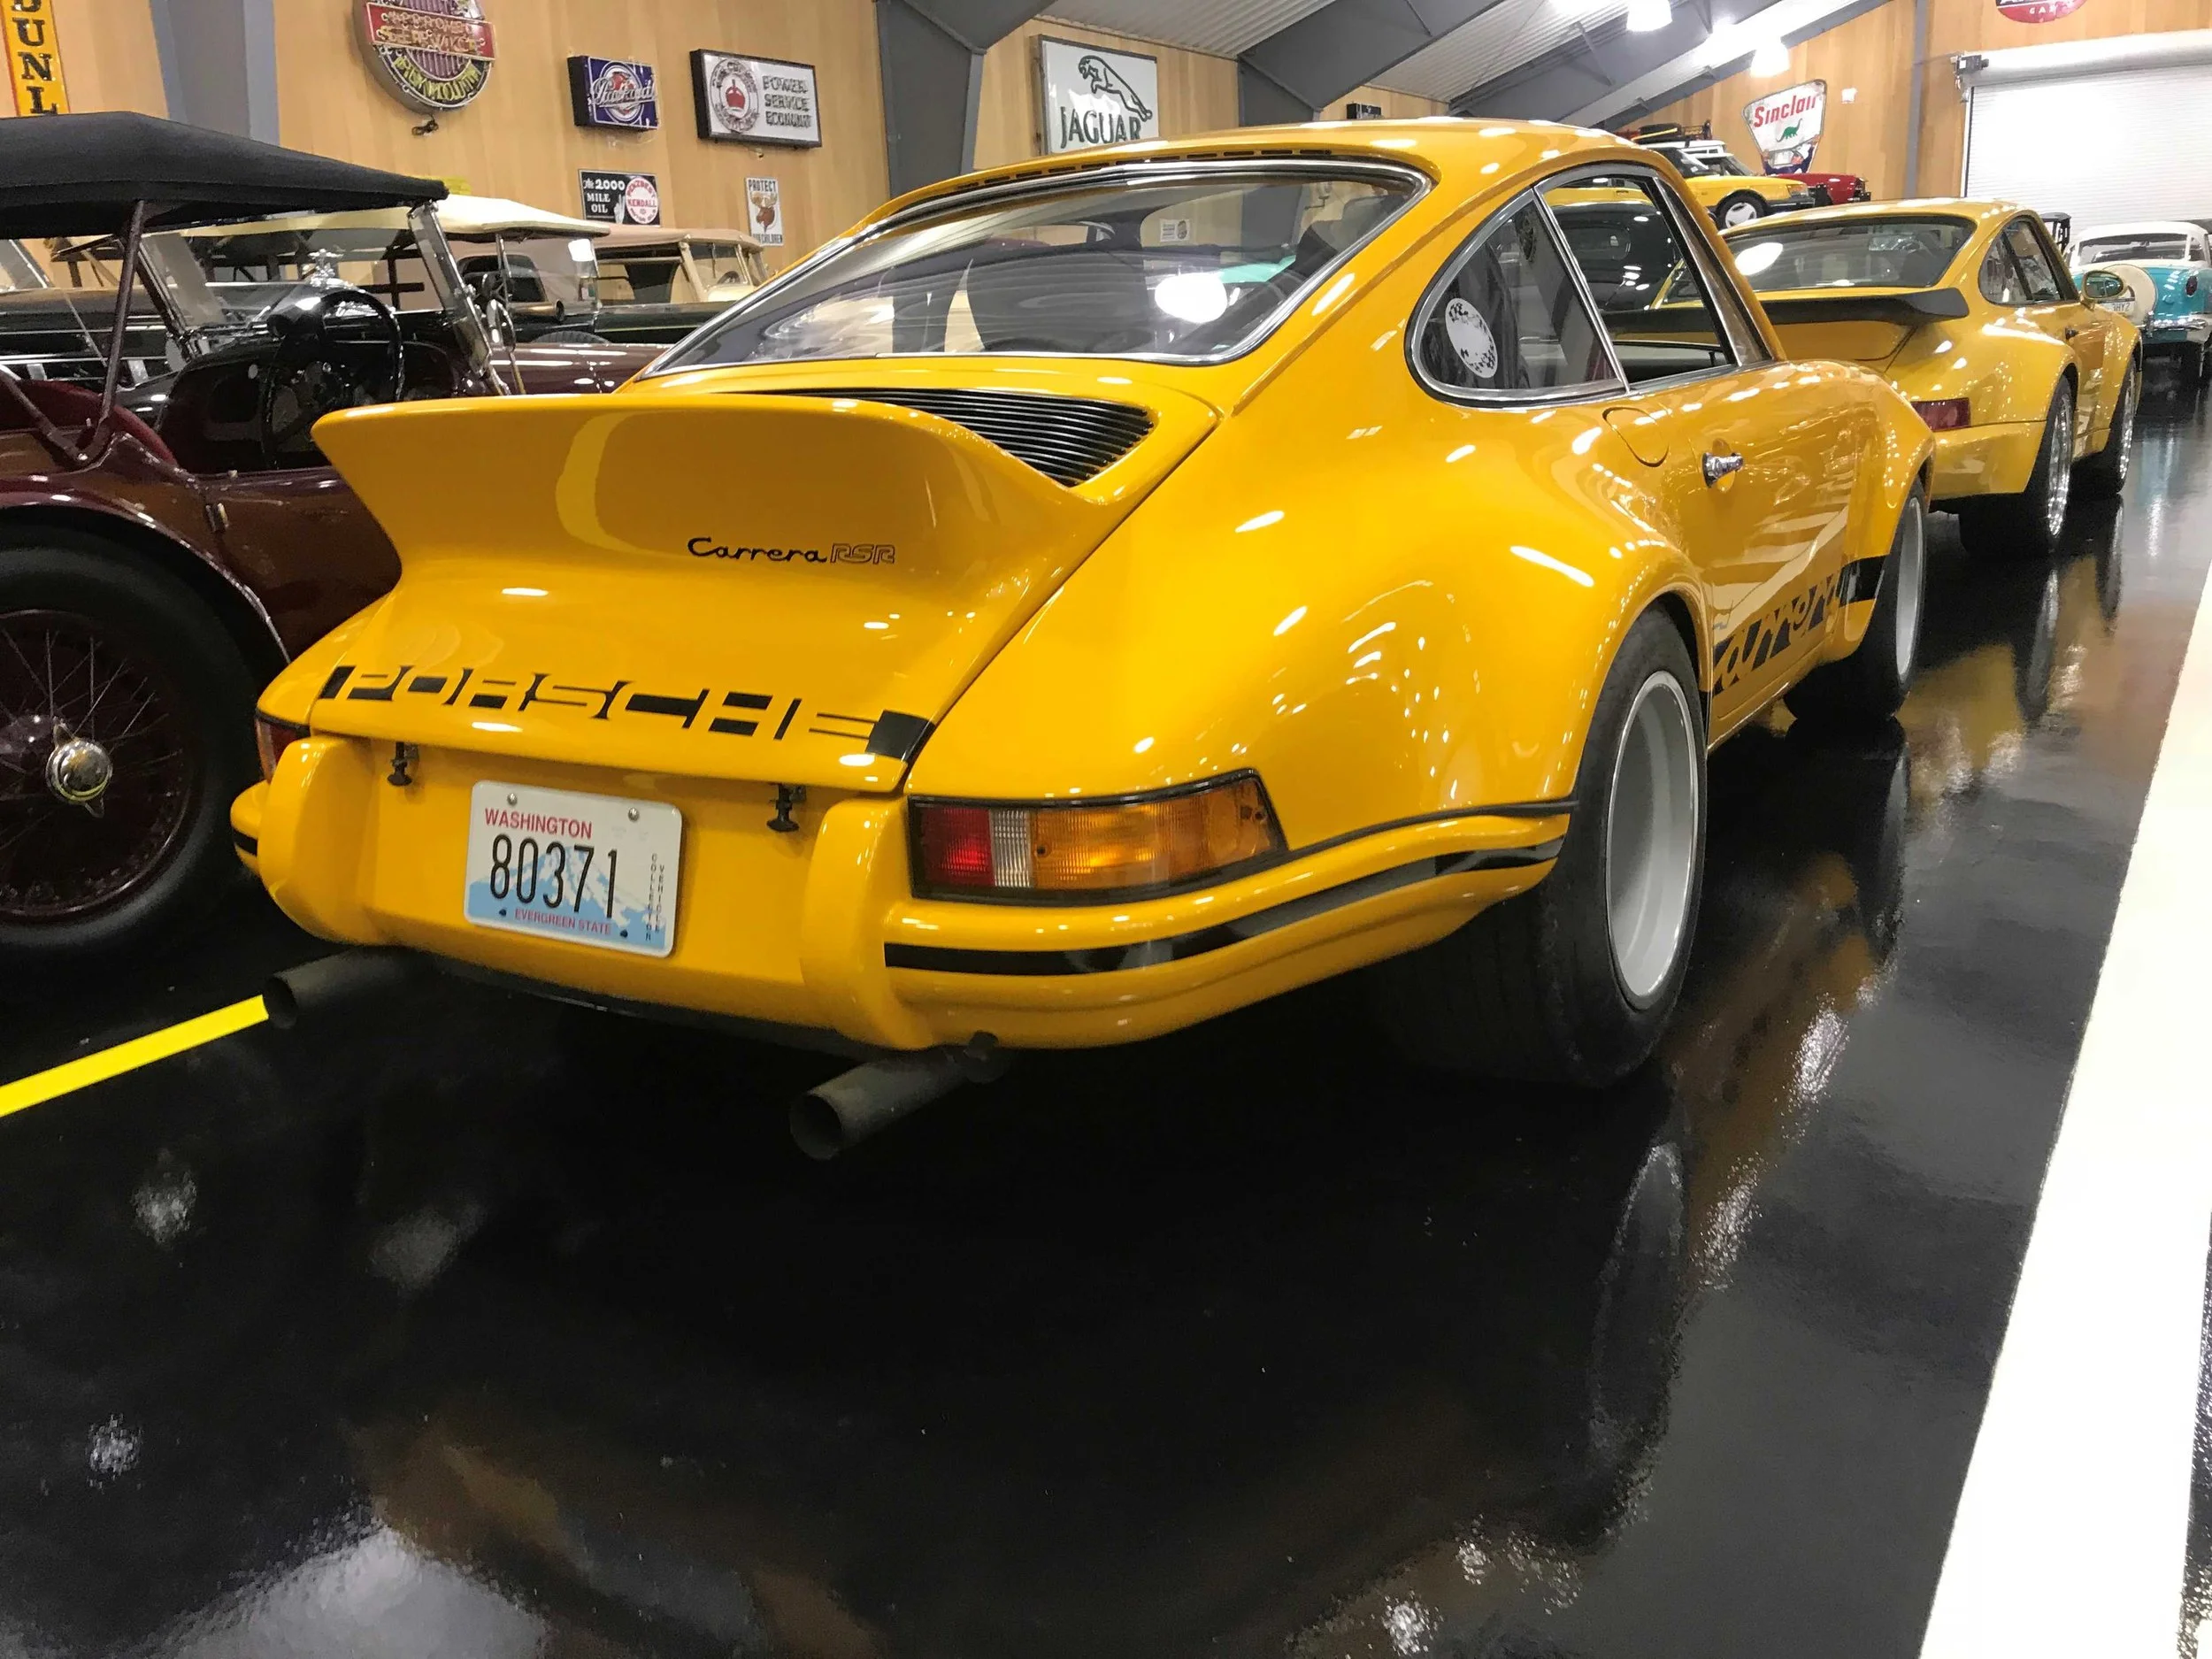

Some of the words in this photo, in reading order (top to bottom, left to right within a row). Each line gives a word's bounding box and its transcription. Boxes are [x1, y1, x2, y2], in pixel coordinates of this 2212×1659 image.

[1753, 94, 1817, 128] Sinclair
[1060, 106, 1141, 150] JAGUAR
[587, 193, 611, 203] MILE
[595, 178, 626, 191] 2000
[748, 180, 776, 192] PROTECT
[590, 204, 609, 213] OIL
[687, 536, 827, 563] Carrera
[830, 542, 895, 565] RSR
[334, 664, 882, 750] PORSCHE
[485, 808, 593, 840] WASHINGTON
[490, 833, 618, 919] 80371
[514, 908, 575, 929] EVERGREEN
[579, 919, 611, 935] STATE
